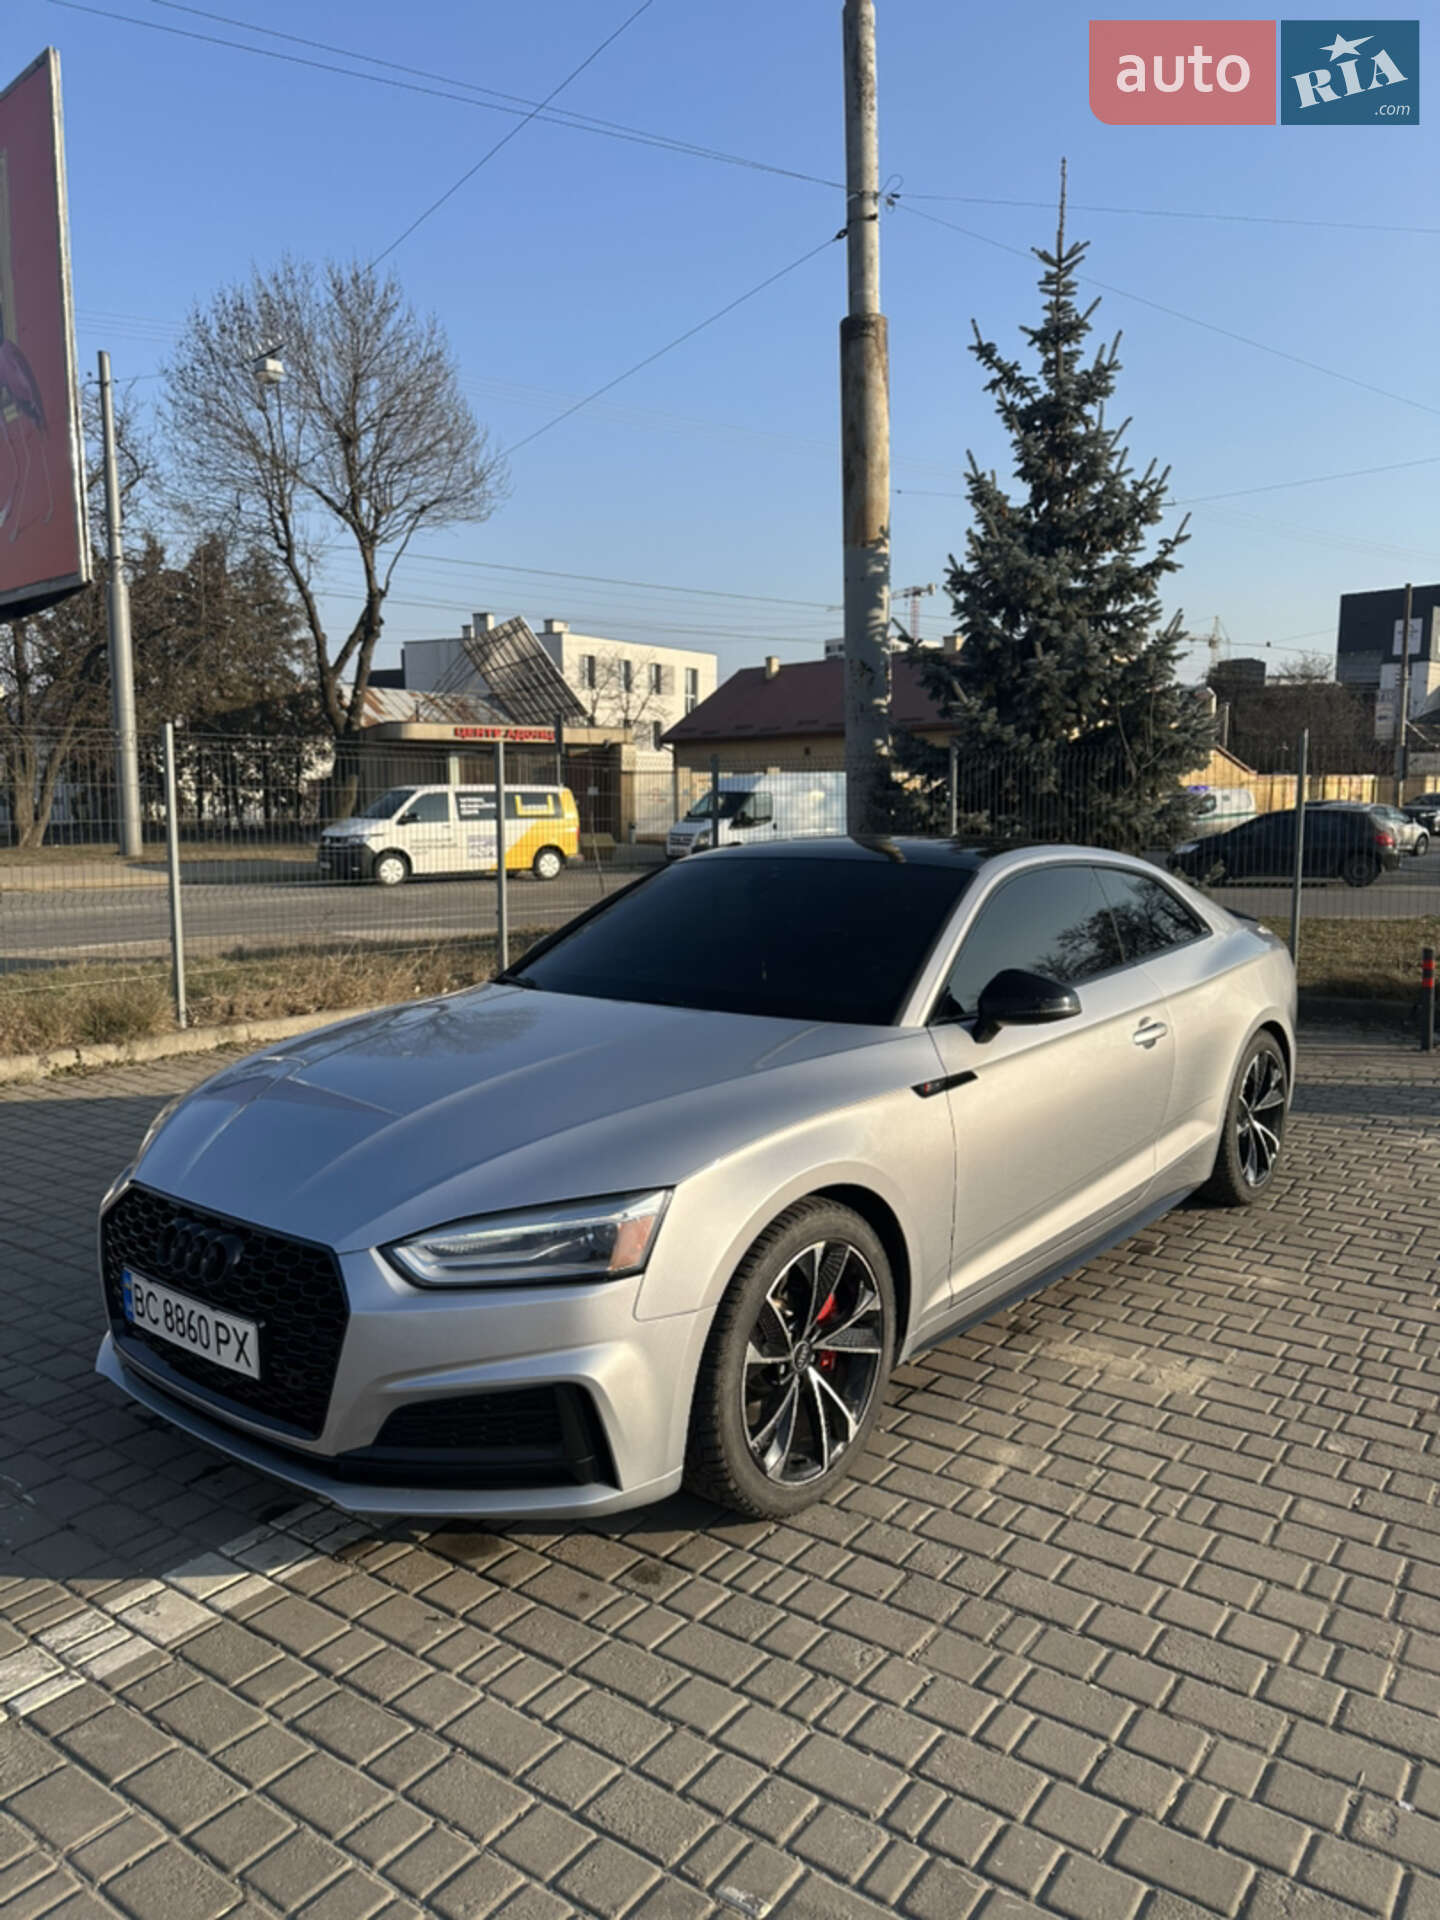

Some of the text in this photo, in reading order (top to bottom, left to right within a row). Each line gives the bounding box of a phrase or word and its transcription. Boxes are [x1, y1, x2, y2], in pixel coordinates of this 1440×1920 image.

[133, 1283, 252, 1368] BC 8860 PX
